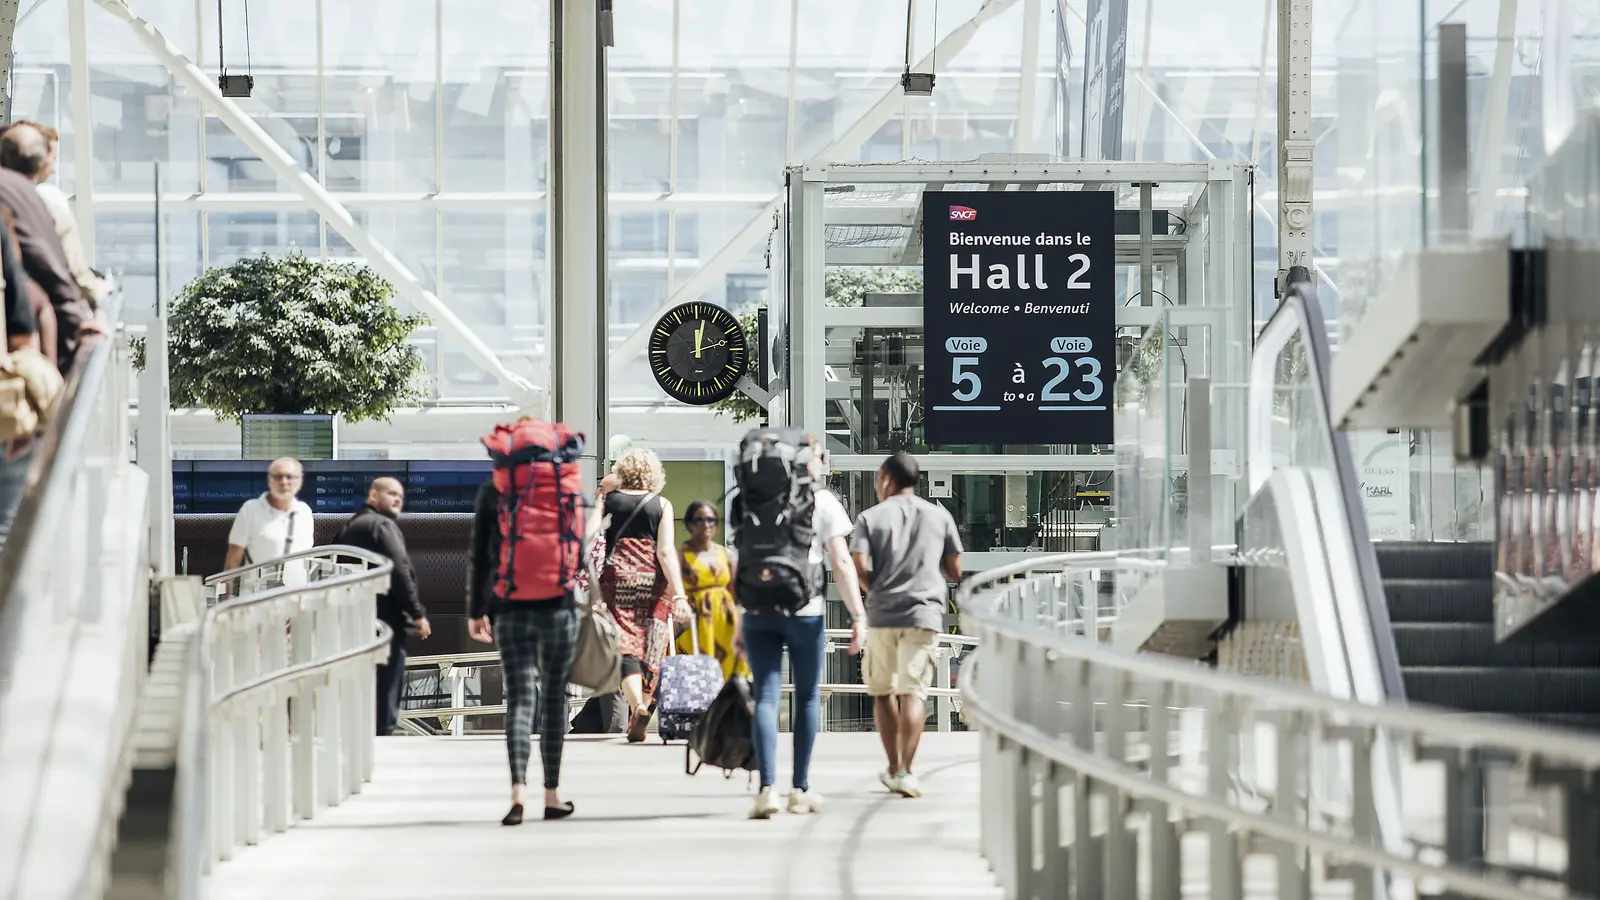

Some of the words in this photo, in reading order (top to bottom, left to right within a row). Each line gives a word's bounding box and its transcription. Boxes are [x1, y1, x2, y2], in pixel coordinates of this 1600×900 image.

[950, 210, 976, 219] SNCF
[949, 232, 1031, 246] Bienvenue
[1035, 232, 1073, 246] dans
[1076, 232, 1091, 246] le
[949, 253, 1049, 290] Hall
[1066, 253, 1091, 290] 2
[949, 302, 1010, 314] Welcome
[1024, 302, 1090, 314] Benvenuti
[951, 340, 981, 351] Voie
[1056, 340, 1086, 351] Voie
[951, 356, 982, 402] 5
[1011, 362, 1026, 384] à
[1040, 356, 1104, 402] 23
[1003, 391, 1016, 402] to
[1026, 393, 1035, 402] a
[1366, 486, 1393, 495] KARL
